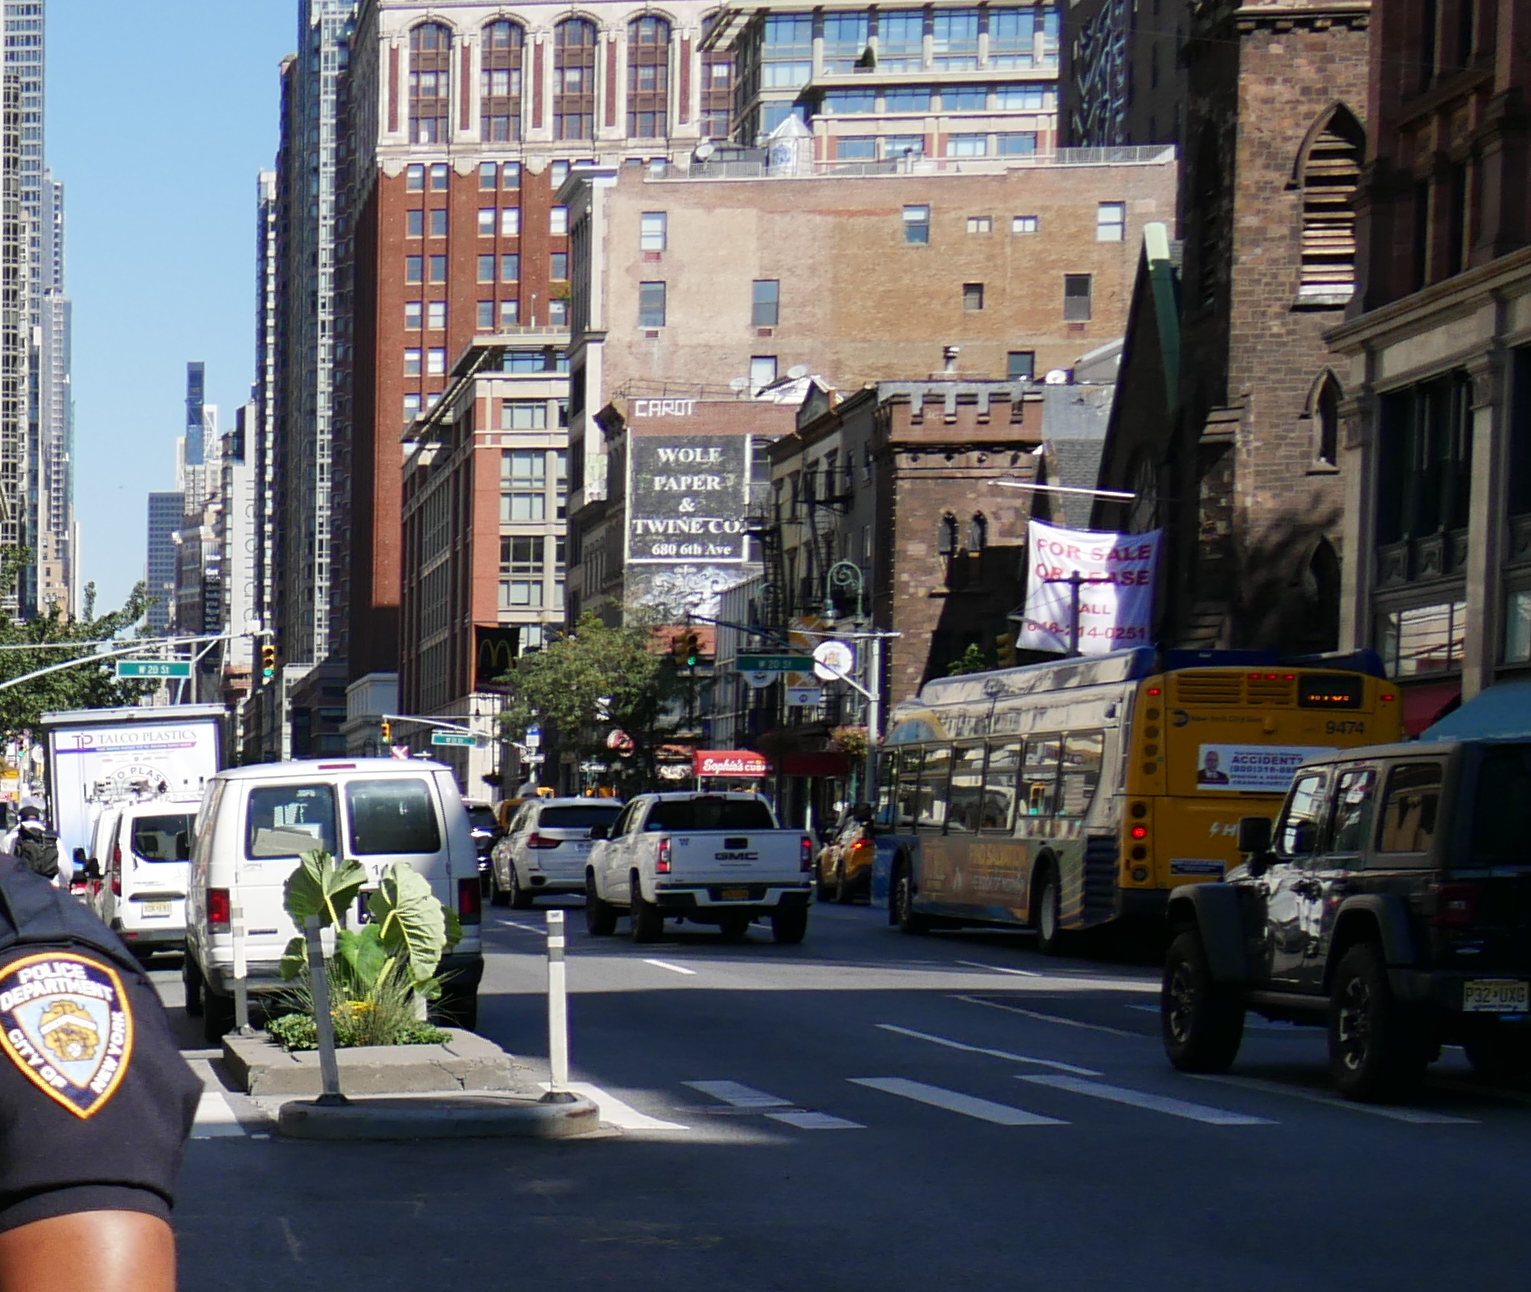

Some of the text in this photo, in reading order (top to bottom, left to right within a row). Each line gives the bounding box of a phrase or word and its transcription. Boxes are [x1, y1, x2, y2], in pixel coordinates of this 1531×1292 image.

[635, 400, 696, 417] CAROT
[657, 447, 722, 463] WOLF
[653, 475, 722, 491] PAPER
[678, 497, 696, 513] &
[632, 519, 704, 534] TWINE
[651, 543, 732, 556] 680 6th Ave
[1037, 538, 1152, 562] FOR SALE
[1035, 562, 1150, 586] OR EASE
[1075, 602, 1112, 615] ALL
[1325, 720, 1365, 735] 9474
[97, 732, 139, 745] TALCO
[142, 729, 197, 742] PLASTICS
[1231, 755, 1304, 765] ACCIDENT?
[714, 852, 759, 861] GMC
[17, 962, 88, 984] POLICE
[8, 1029, 68, 1088] CITY OF
[90, 1011, 126, 1094] NEW YORK
